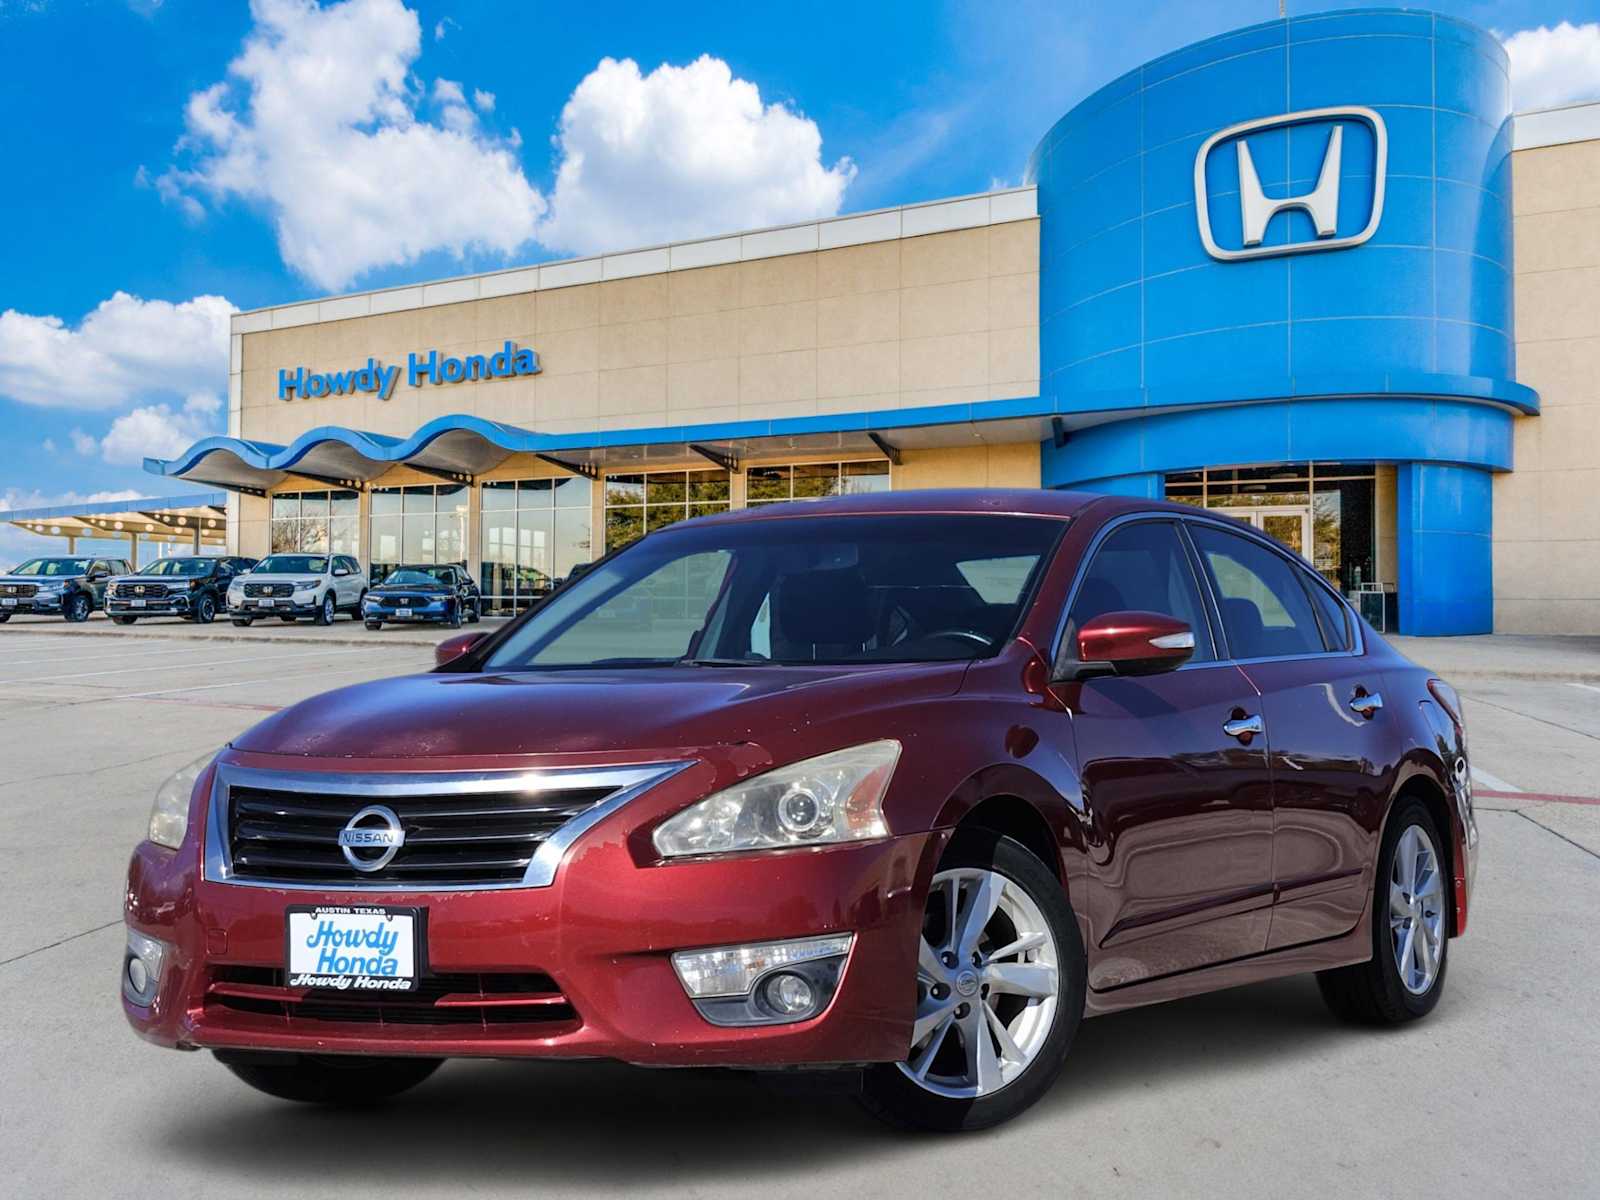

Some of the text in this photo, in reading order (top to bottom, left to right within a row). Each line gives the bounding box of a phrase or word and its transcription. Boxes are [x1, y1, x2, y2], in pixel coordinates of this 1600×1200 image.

[279, 341, 542, 401] Howdy Honda
[342, 832, 394, 843] NISSAN
[353, 907, 386, 915] TEXAS
[306, 920, 399, 956] Howdy
[316, 947, 399, 976] Honda
[290, 974, 412, 990] Howdy Honda
